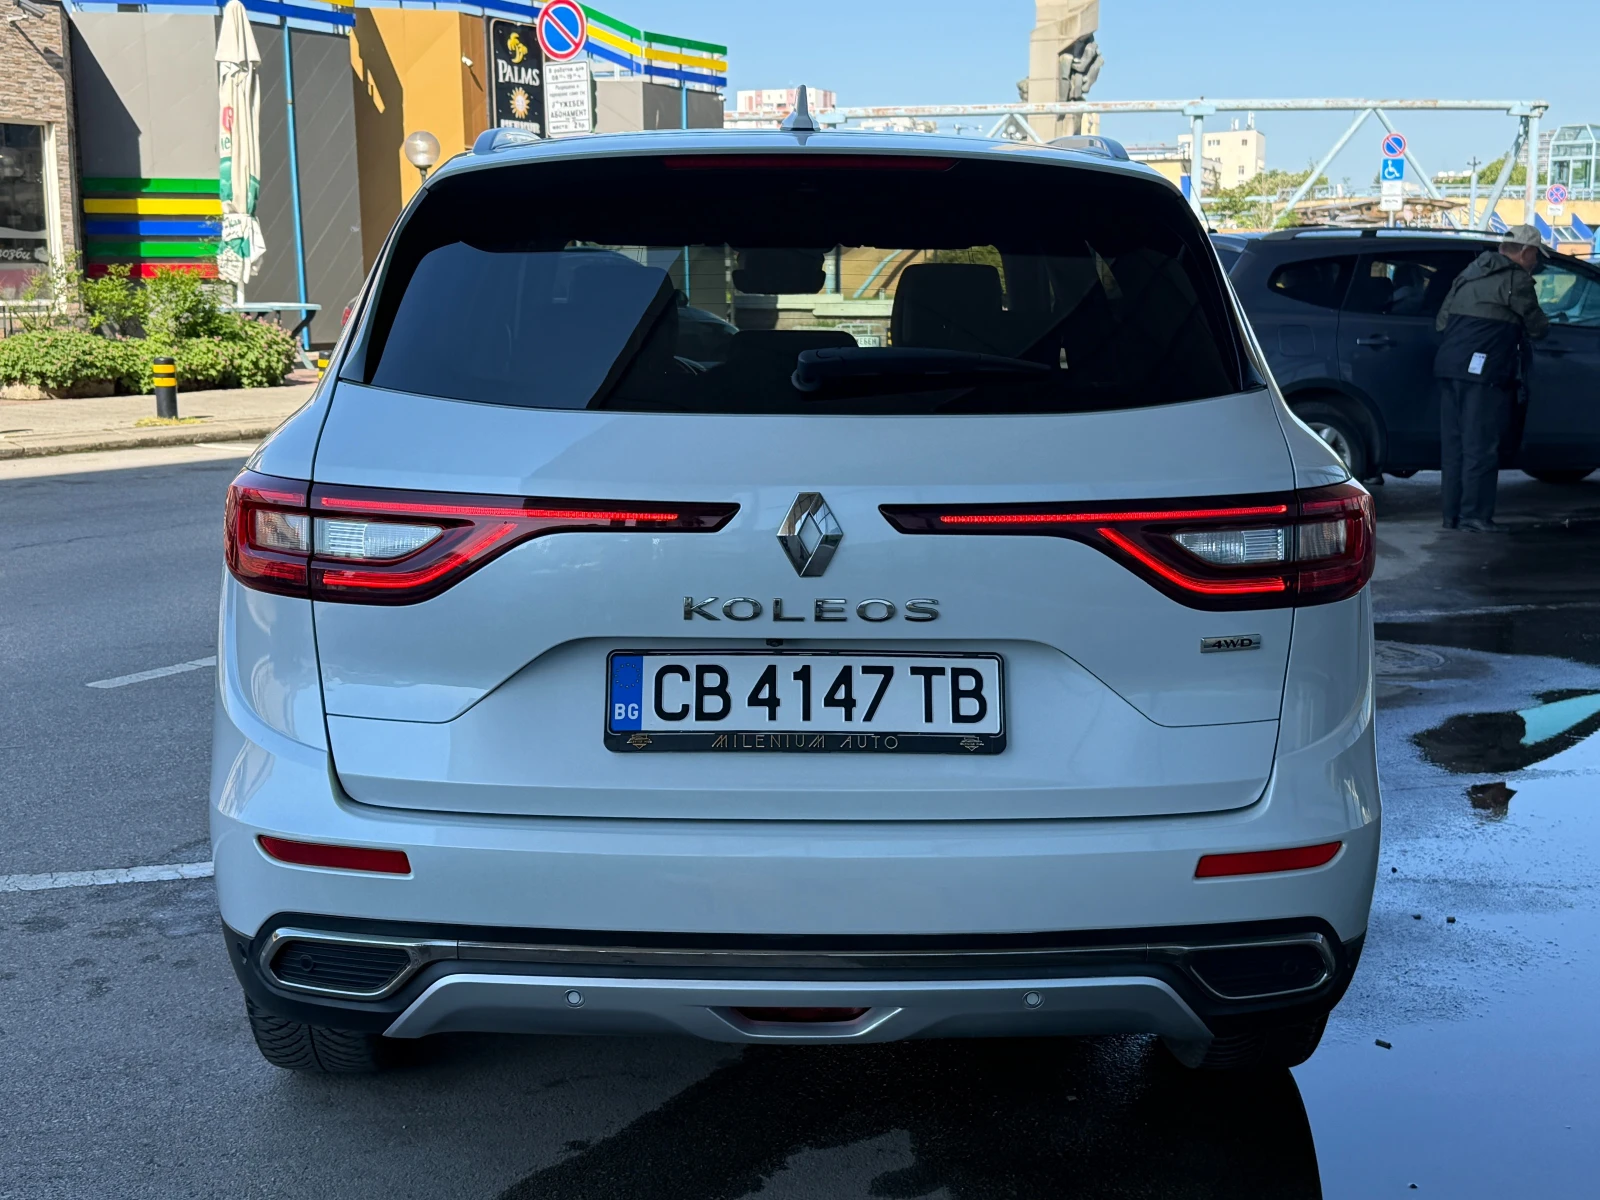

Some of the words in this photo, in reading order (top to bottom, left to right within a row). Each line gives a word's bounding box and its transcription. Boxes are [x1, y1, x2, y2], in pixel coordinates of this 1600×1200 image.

[497, 59, 540, 86] PALMS
[683, 596, 940, 623] KOLEOS
[1212, 638, 1253, 649] 4WD
[653, 664, 732, 722] CB
[747, 664, 895, 722] 4147
[909, 666, 988, 724] TB
[614, 703, 639, 721] BG
[712, 733, 825, 749] MILENIUM
[840, 735, 899, 750] AUTO
